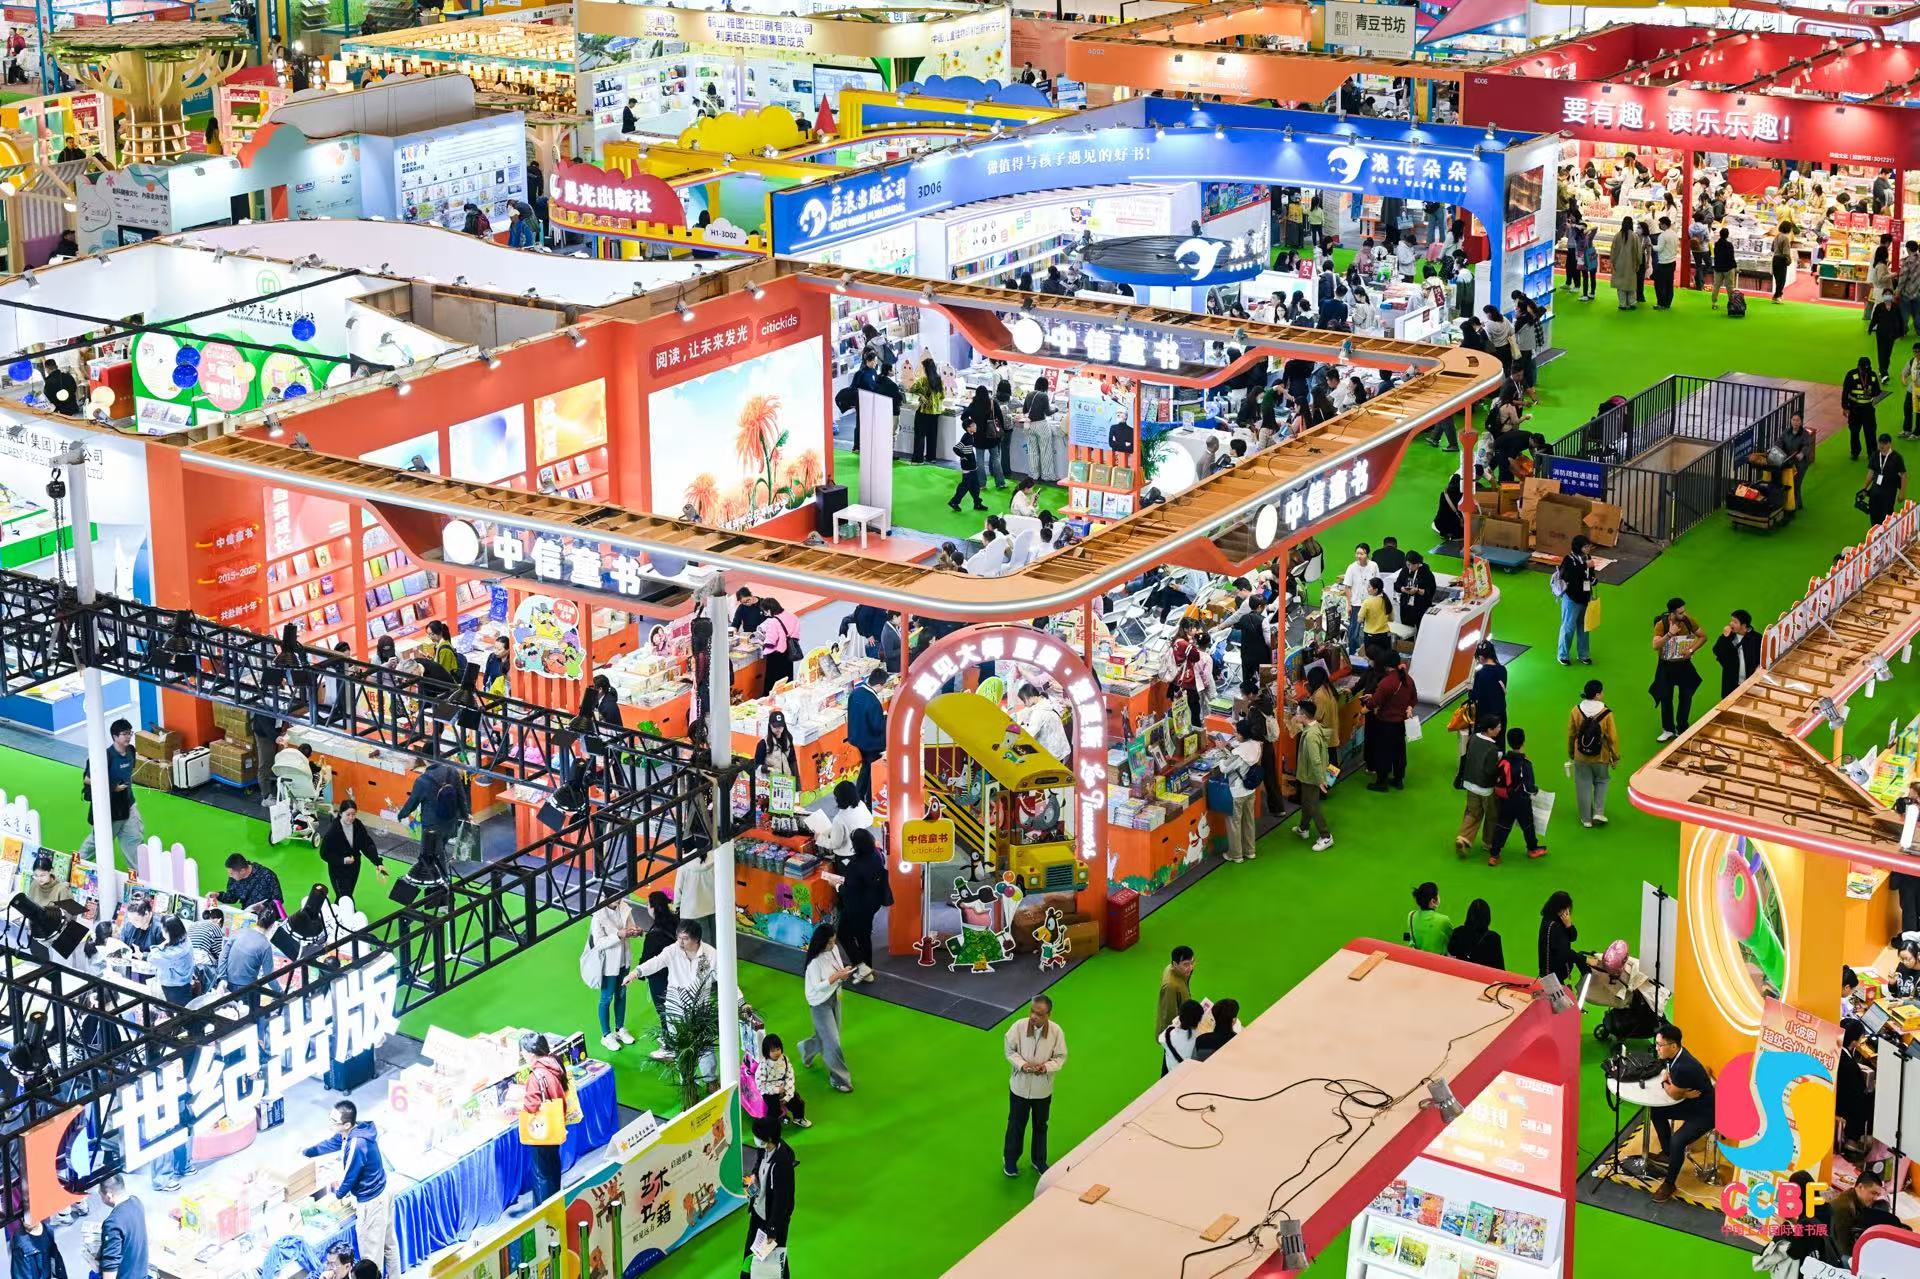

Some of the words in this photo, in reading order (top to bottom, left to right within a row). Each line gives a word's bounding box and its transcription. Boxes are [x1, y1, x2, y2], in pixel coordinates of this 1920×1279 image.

[707, 16, 813, 36] 鹤山雅图仕印刷有限公司
[1356, 14, 1406, 33] 青豆书坊
[1371, 152, 1467, 182] 浪花朵朵
[564, 179, 653, 213] 晨光出版社
[828, 177, 906, 221] 后浪出版公司
[917, 180, 942, 199] 3D06
[1440, 183, 1468, 193] KIDS
[710, 229, 737, 240] H1-3D02
[761, 313, 798, 336] citickids
[1051, 323, 1180, 370] 中信童书
[1553, 468, 1599, 481] 消防疏散通道前
[1285, 458, 1369, 531] 中信童书
[216, 527, 255, 548] 中信童书
[494, 529, 641, 596] 中信童书
[220, 600, 257, 621] 共赴新十年
[907, 833, 949, 844] 中信童书
[912, 846, 945, 855] citickids
[1784, 1020, 1817, 1044] 小彼恩
[111, 951, 399, 1174] 世纪出版
[390, 1085, 408, 1112] 6
[640, 1166, 671, 1199] 艺术
[640, 1199, 672, 1228] 书籍
